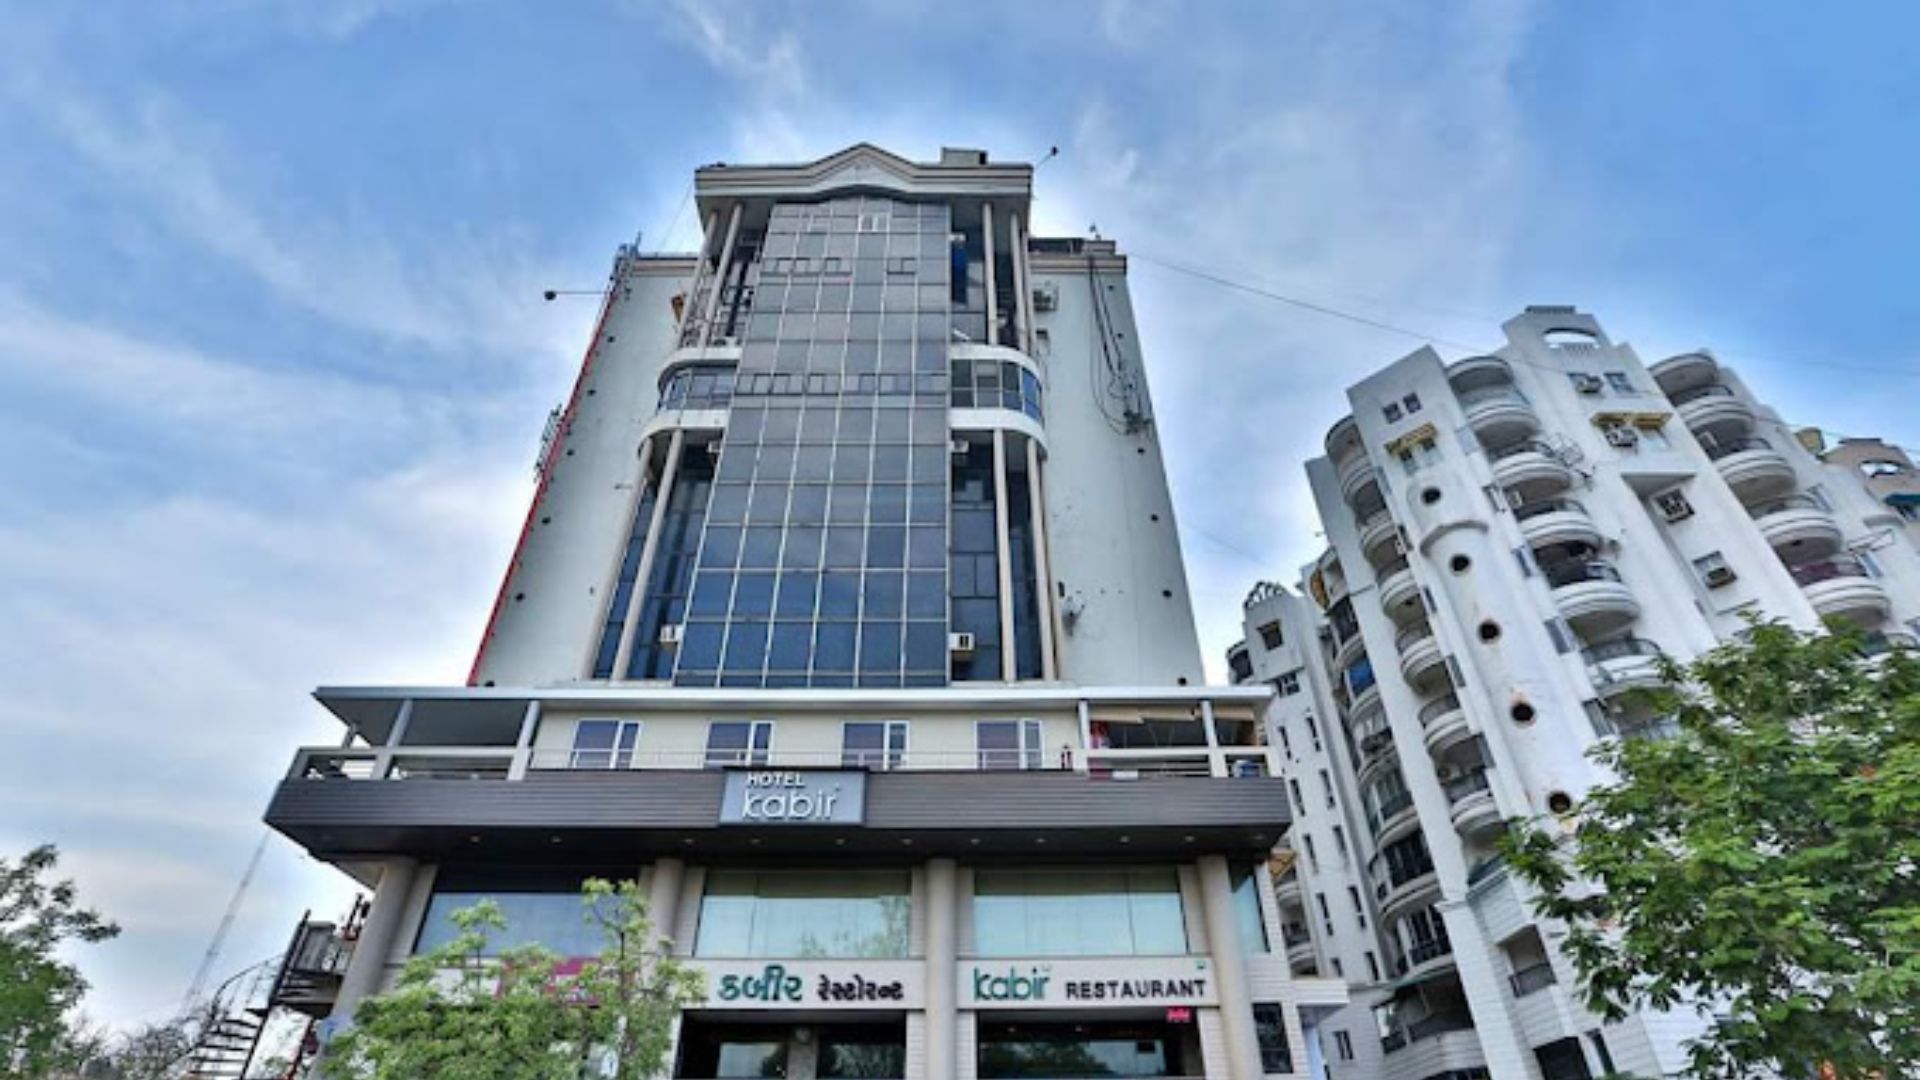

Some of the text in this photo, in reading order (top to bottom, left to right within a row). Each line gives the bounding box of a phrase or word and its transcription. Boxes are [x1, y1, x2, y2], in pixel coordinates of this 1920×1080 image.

[747, 772, 805, 786] HOTEL
[742, 787, 838, 818] kabir
[718, 964, 803, 1001] કબીર
[973, 967, 1206, 1001] kabir RESTAURANT
